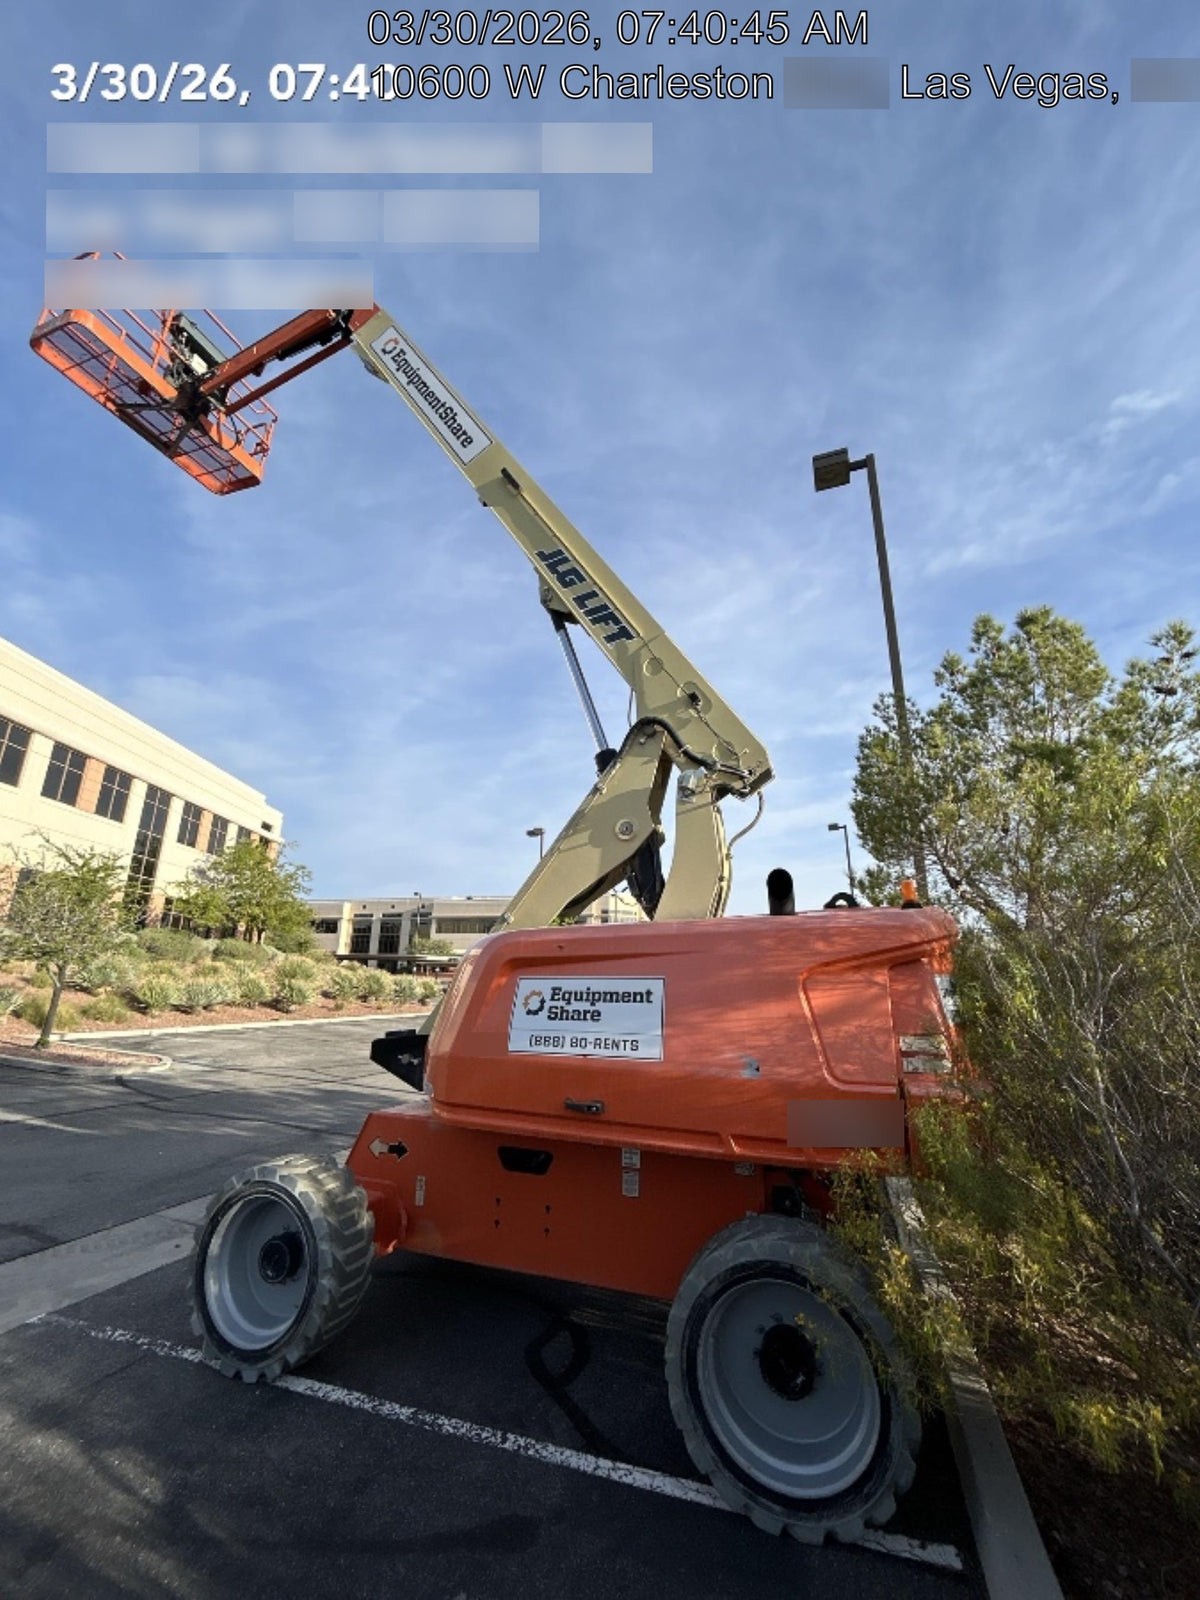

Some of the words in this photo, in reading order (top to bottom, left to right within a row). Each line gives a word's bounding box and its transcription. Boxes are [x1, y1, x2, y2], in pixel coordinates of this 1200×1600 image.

[390, 348, 474, 449] EquipmentShare
[535, 548, 588, 590] JLG
[572, 589, 637, 647] LIFT
[549, 986, 653, 1007] Equipment
[547, 1005, 602, 1022] Share
[570, 1037, 639, 1052] 80-RENTS
